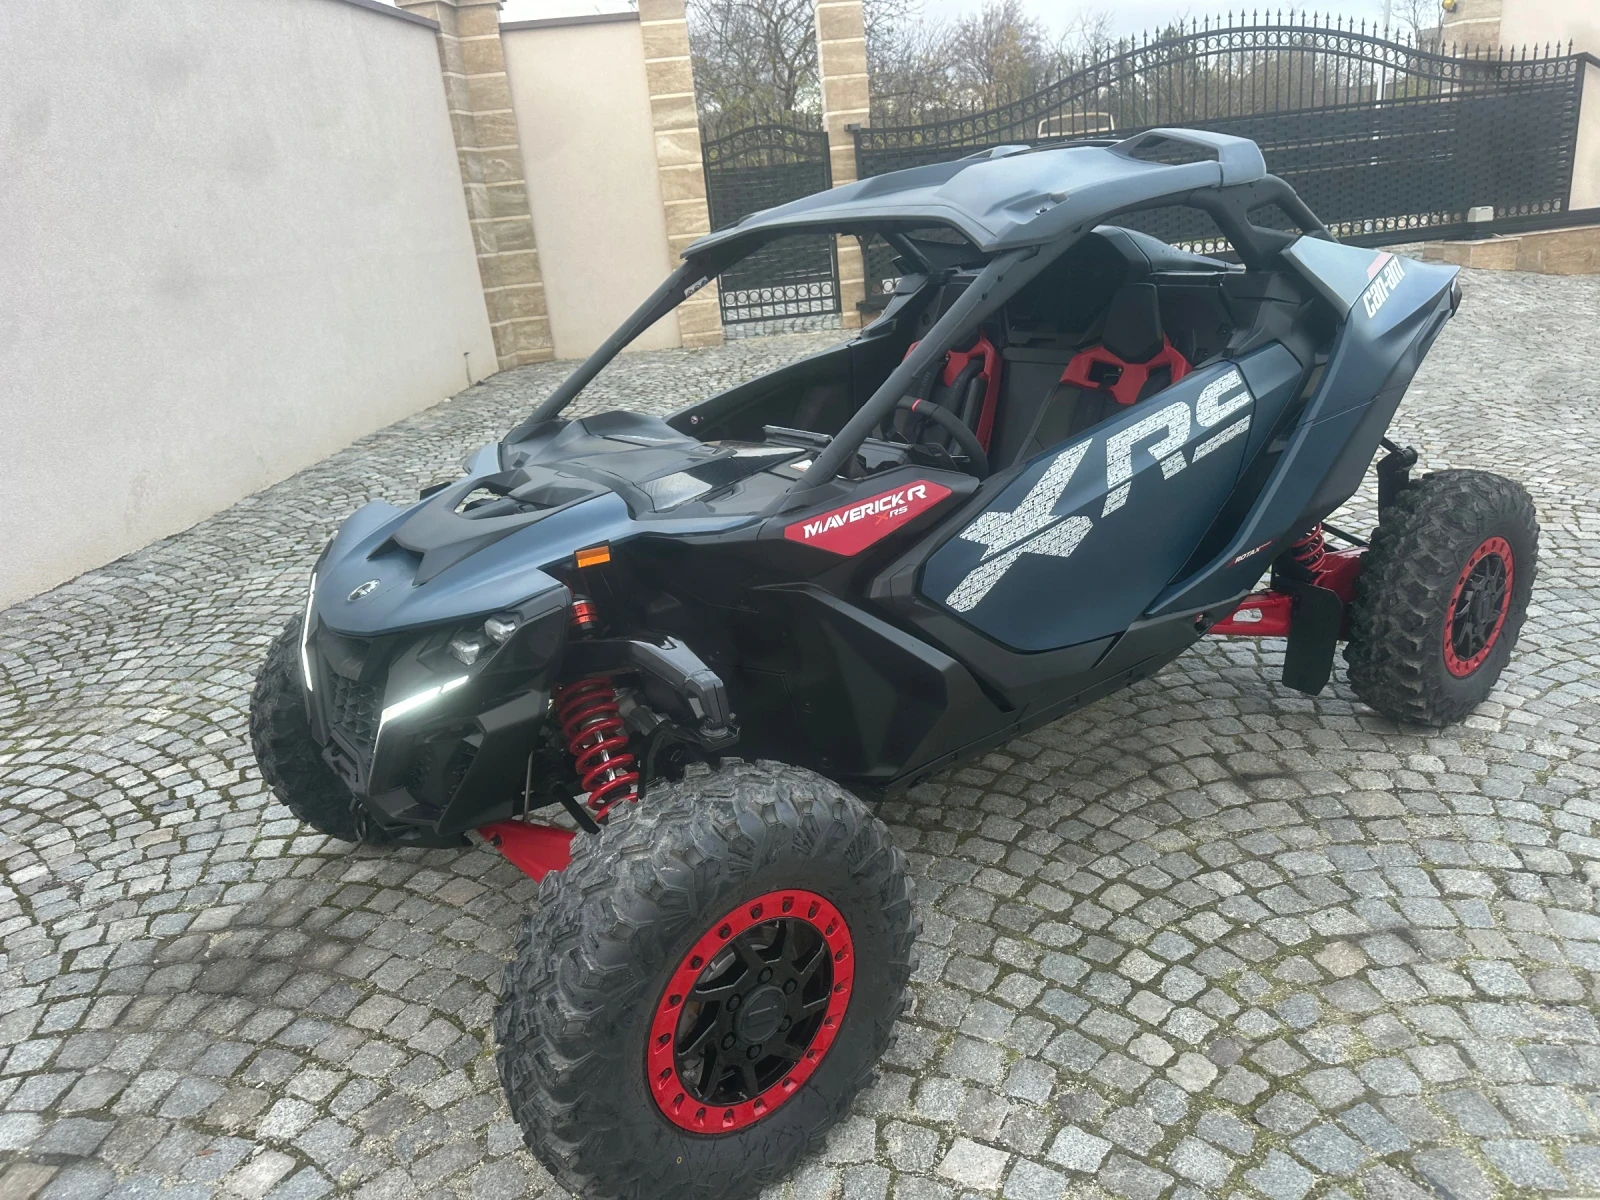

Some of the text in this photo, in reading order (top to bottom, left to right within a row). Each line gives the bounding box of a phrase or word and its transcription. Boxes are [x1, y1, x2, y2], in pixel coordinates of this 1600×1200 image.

[803, 484, 927, 539] MAVERICK R
[1234, 545, 1265, 564] ROTAX
